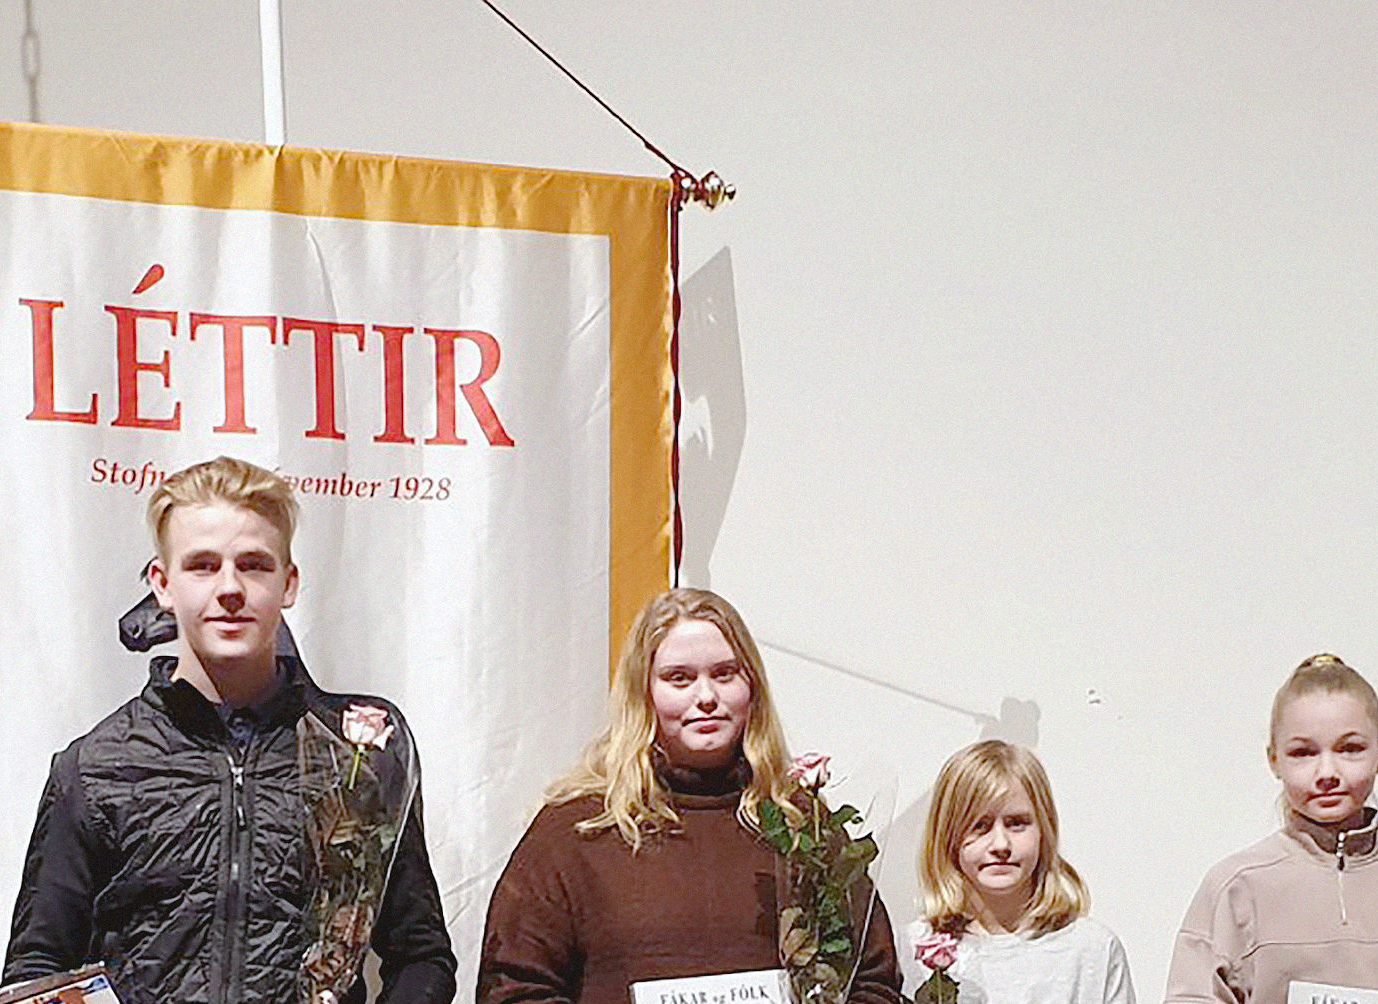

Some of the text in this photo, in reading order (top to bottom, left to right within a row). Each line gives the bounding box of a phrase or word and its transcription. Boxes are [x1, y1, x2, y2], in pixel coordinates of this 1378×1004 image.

[19, 263, 515, 448] LÉTTIR
[90, 458, 166, 495] Stofn
[389, 477, 452, 501] 1928
[730, 984, 769, 1002] FÓLK
